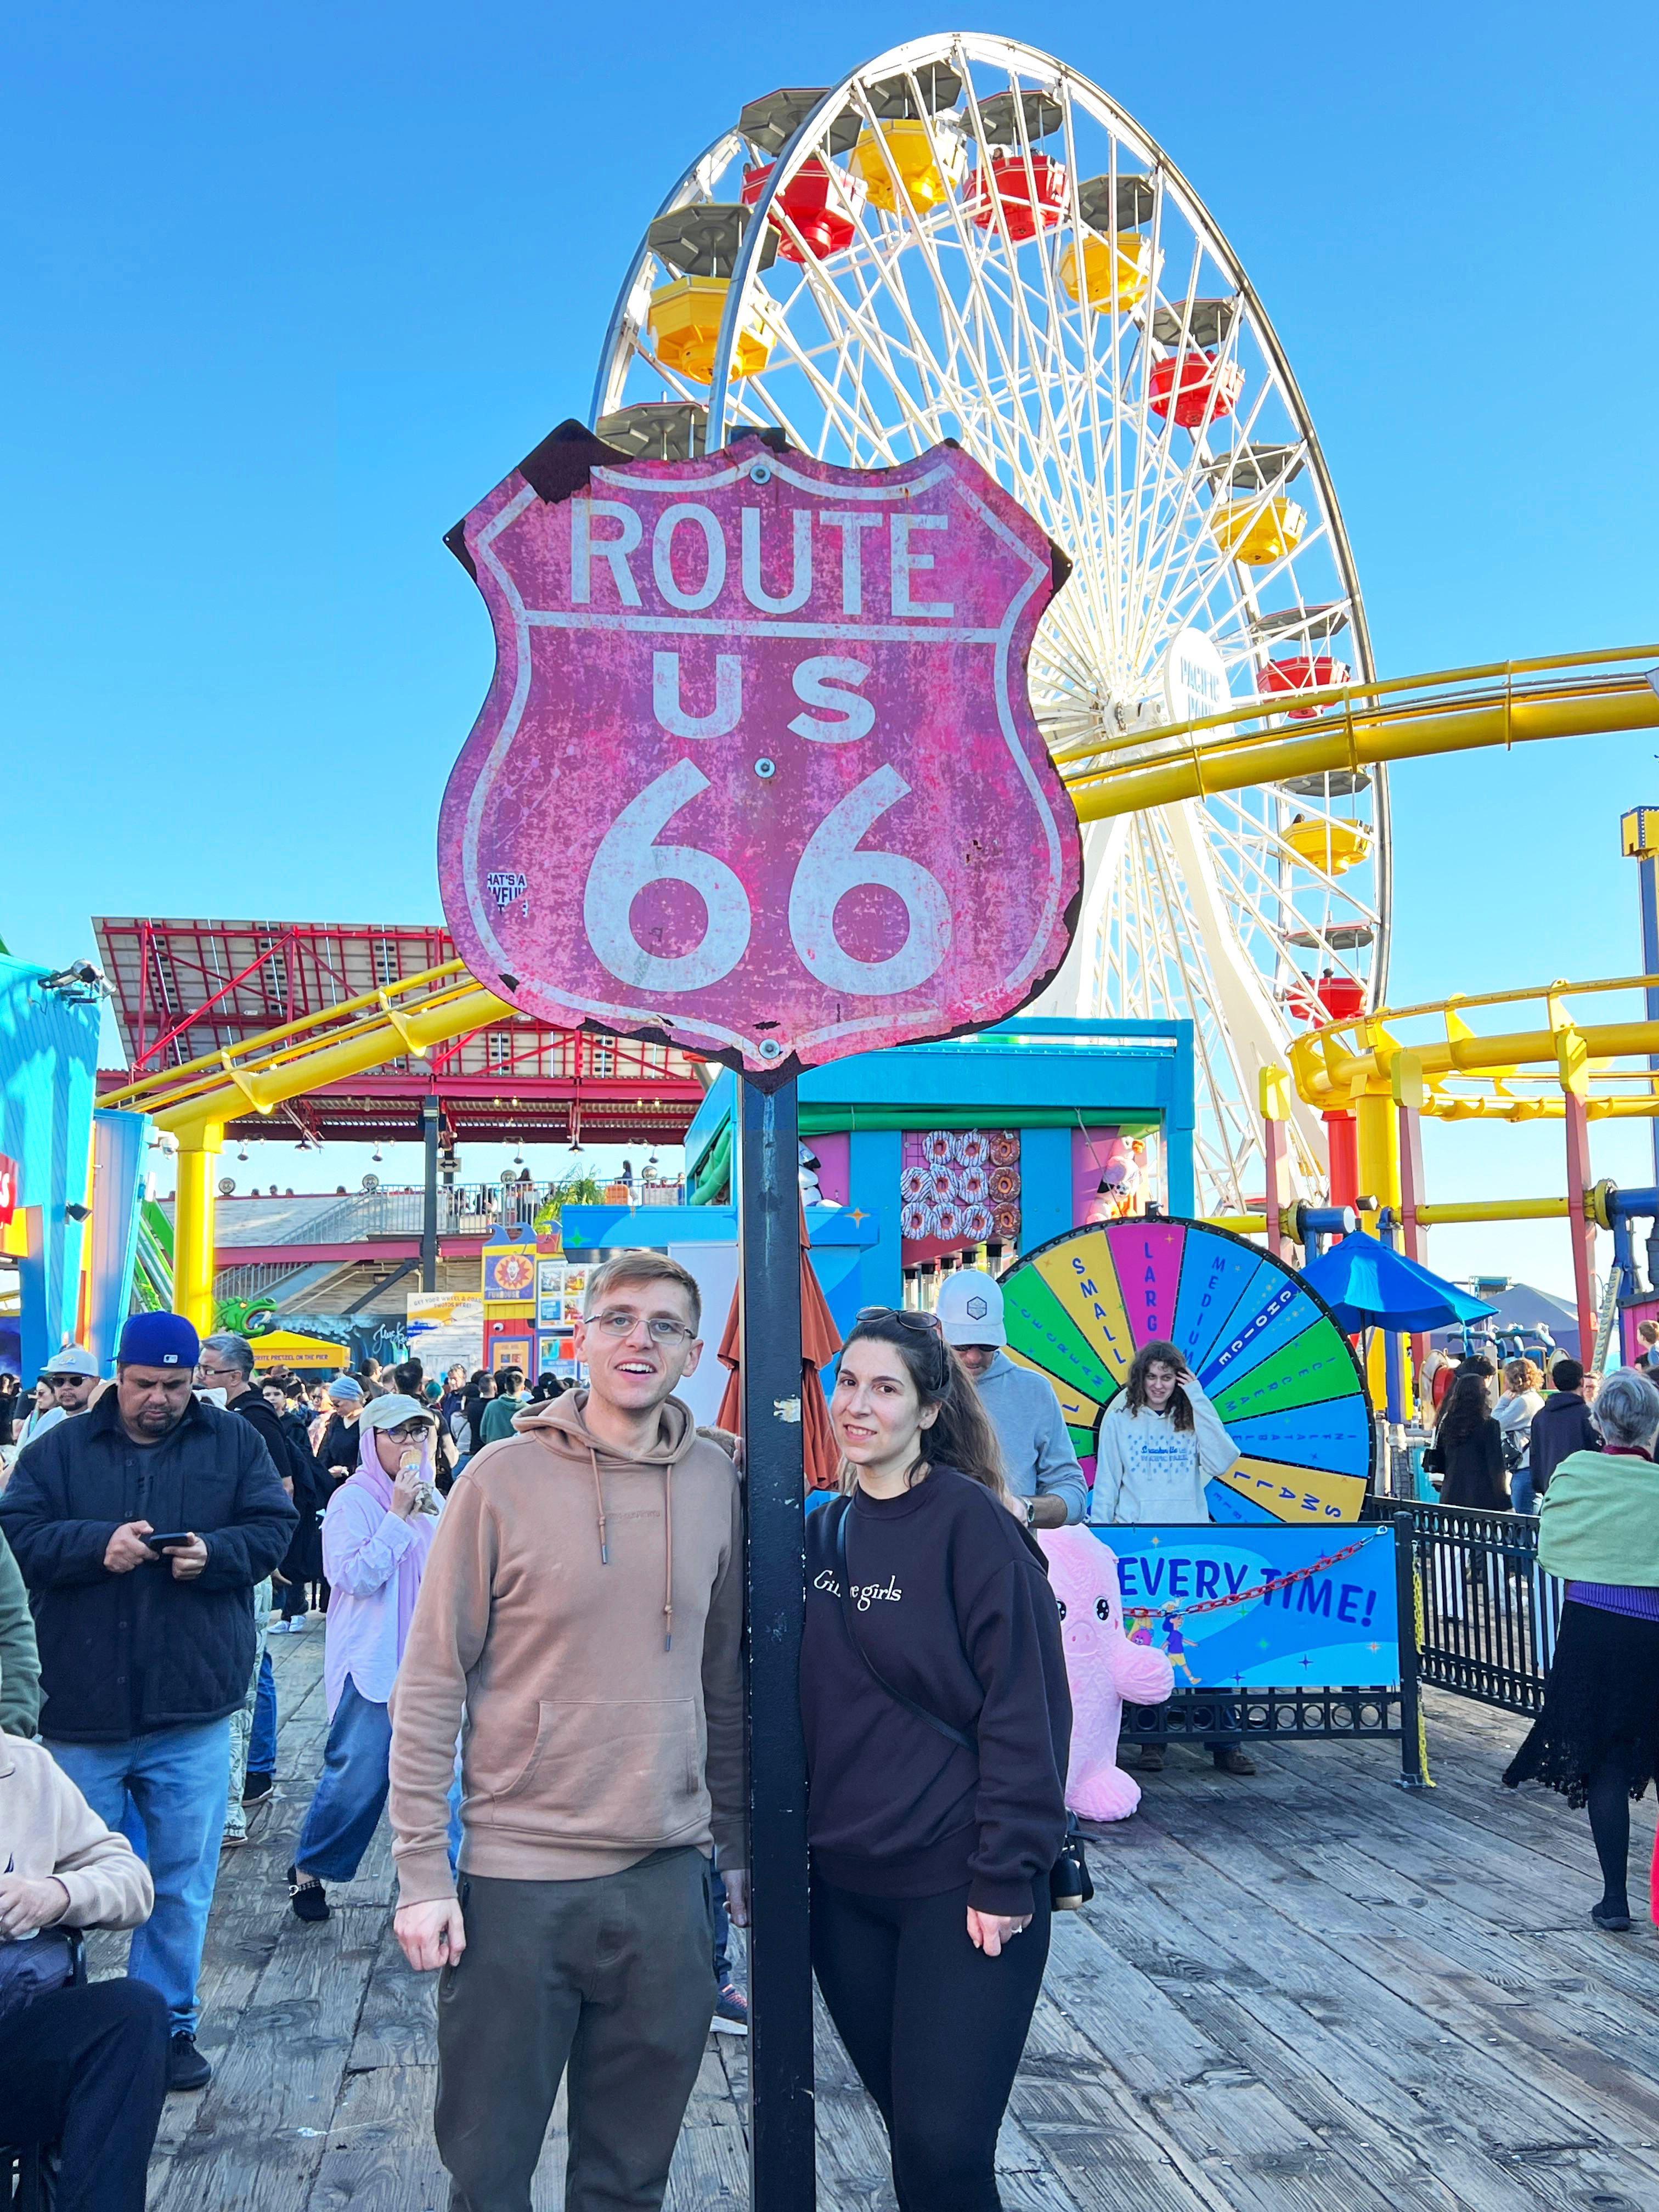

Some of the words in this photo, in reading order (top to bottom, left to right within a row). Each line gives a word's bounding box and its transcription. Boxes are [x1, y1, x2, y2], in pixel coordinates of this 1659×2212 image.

[571, 498, 956, 618] ROUTE
[1181, 656, 1220, 703] PACIFIC
[583, 756, 952, 996] 66
[1009, 1299, 1043, 1329] ICE
[1046, 1332, 1104, 1388] CREAM
[1072, 1257, 1126, 1364] SMALL
[1182, 1256, 1226, 1365] MEDIUM
[1218, 1290, 1291, 1365] CHOICE
[1224, 1375, 1293, 1413] CREAM
[1299, 1356, 1336, 1377] ICE
[1233, 1470, 1341, 1518] SMALL
[1119, 1556, 1248, 1599] EVERY
[1259, 1567, 1376, 1627] TIME!
